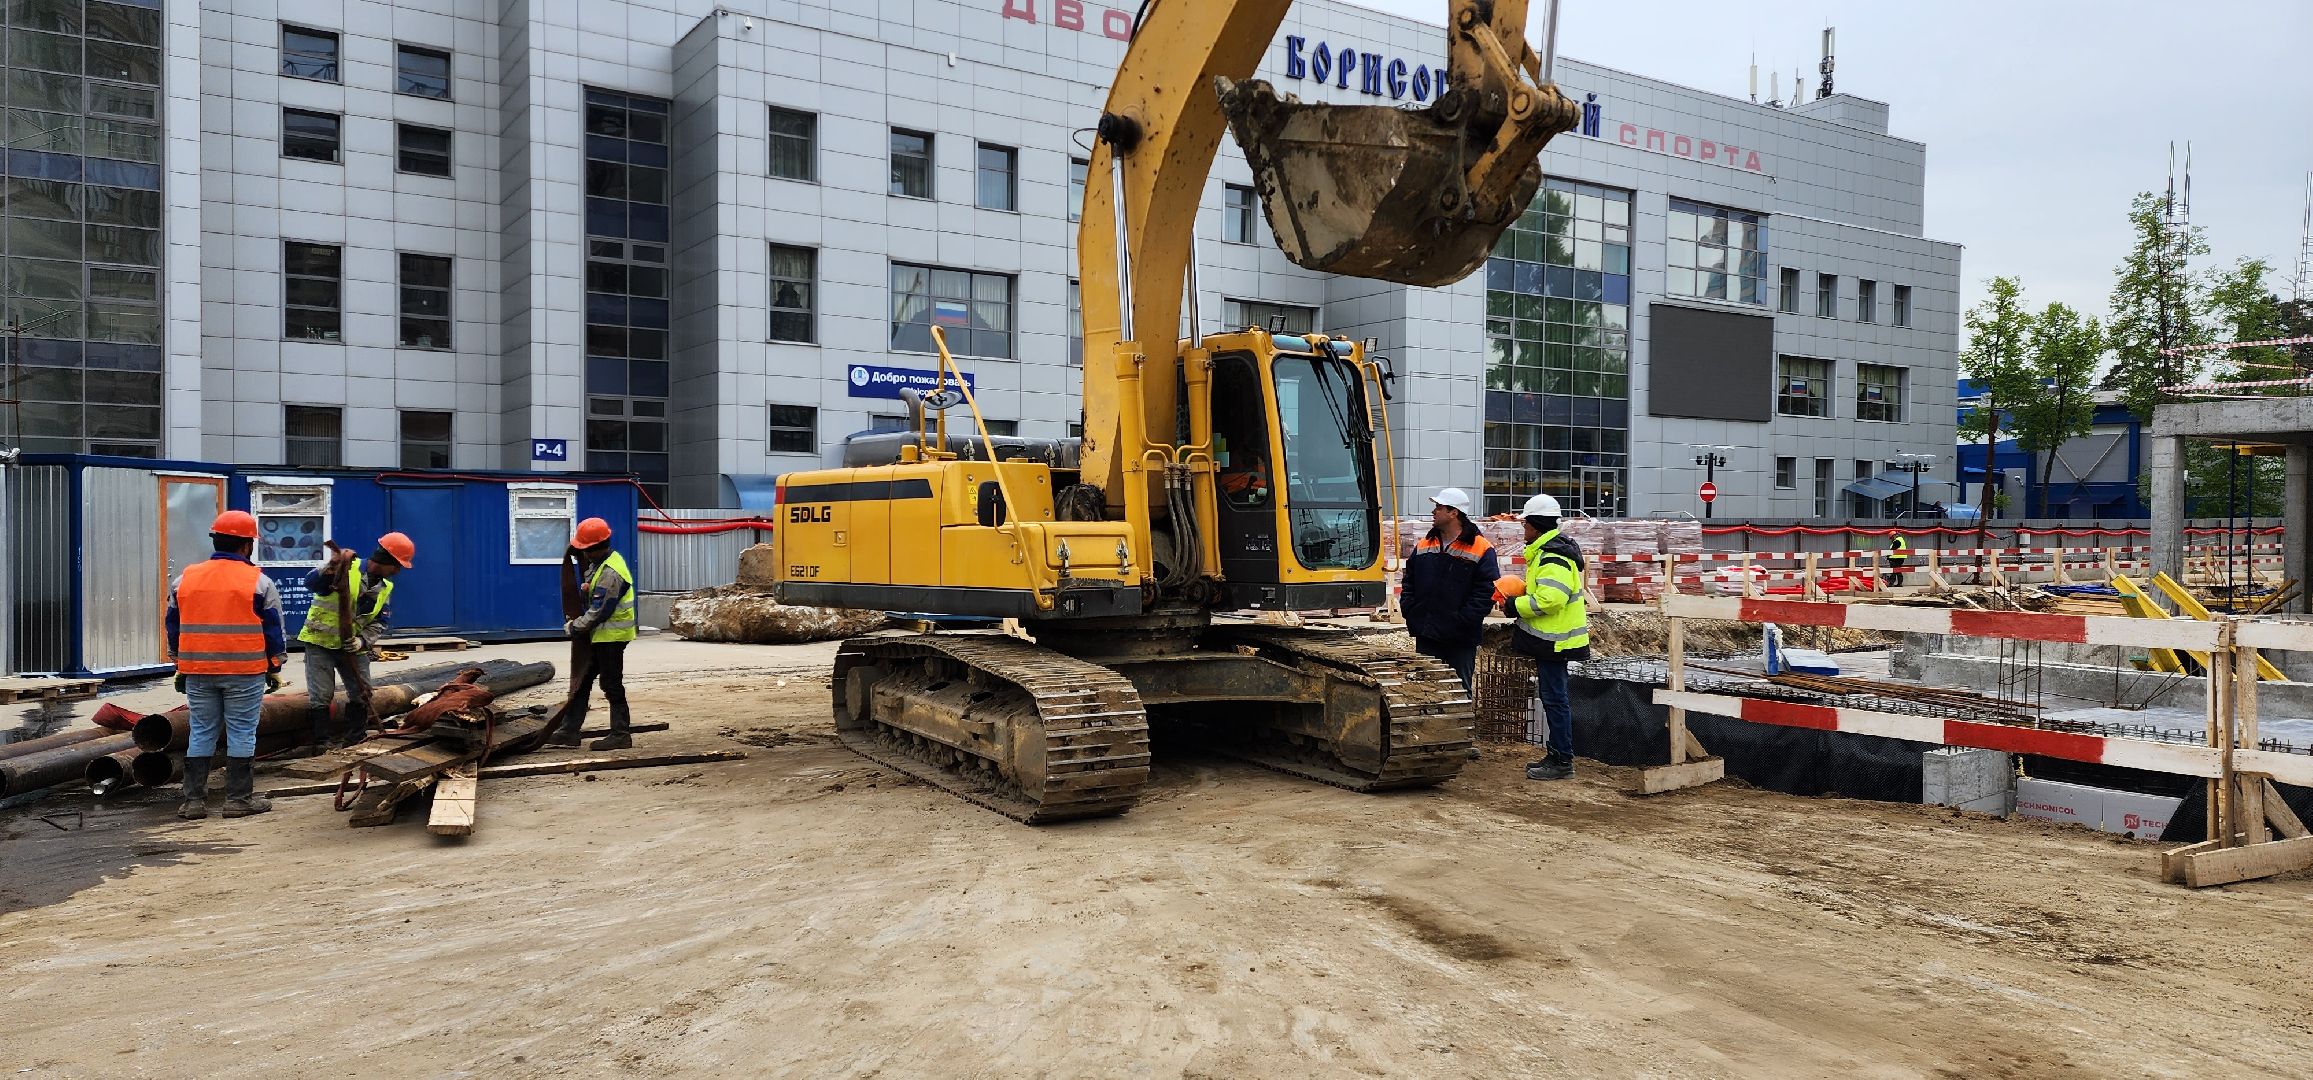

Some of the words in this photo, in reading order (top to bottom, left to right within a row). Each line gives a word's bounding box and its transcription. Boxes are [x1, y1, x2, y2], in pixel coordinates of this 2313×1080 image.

[1619, 123, 1761, 172] СПОРТА
[872, 371, 906, 385] Добро
[909, 376, 971, 387] пожаоваь
[790, 505, 831, 523] SDLG
